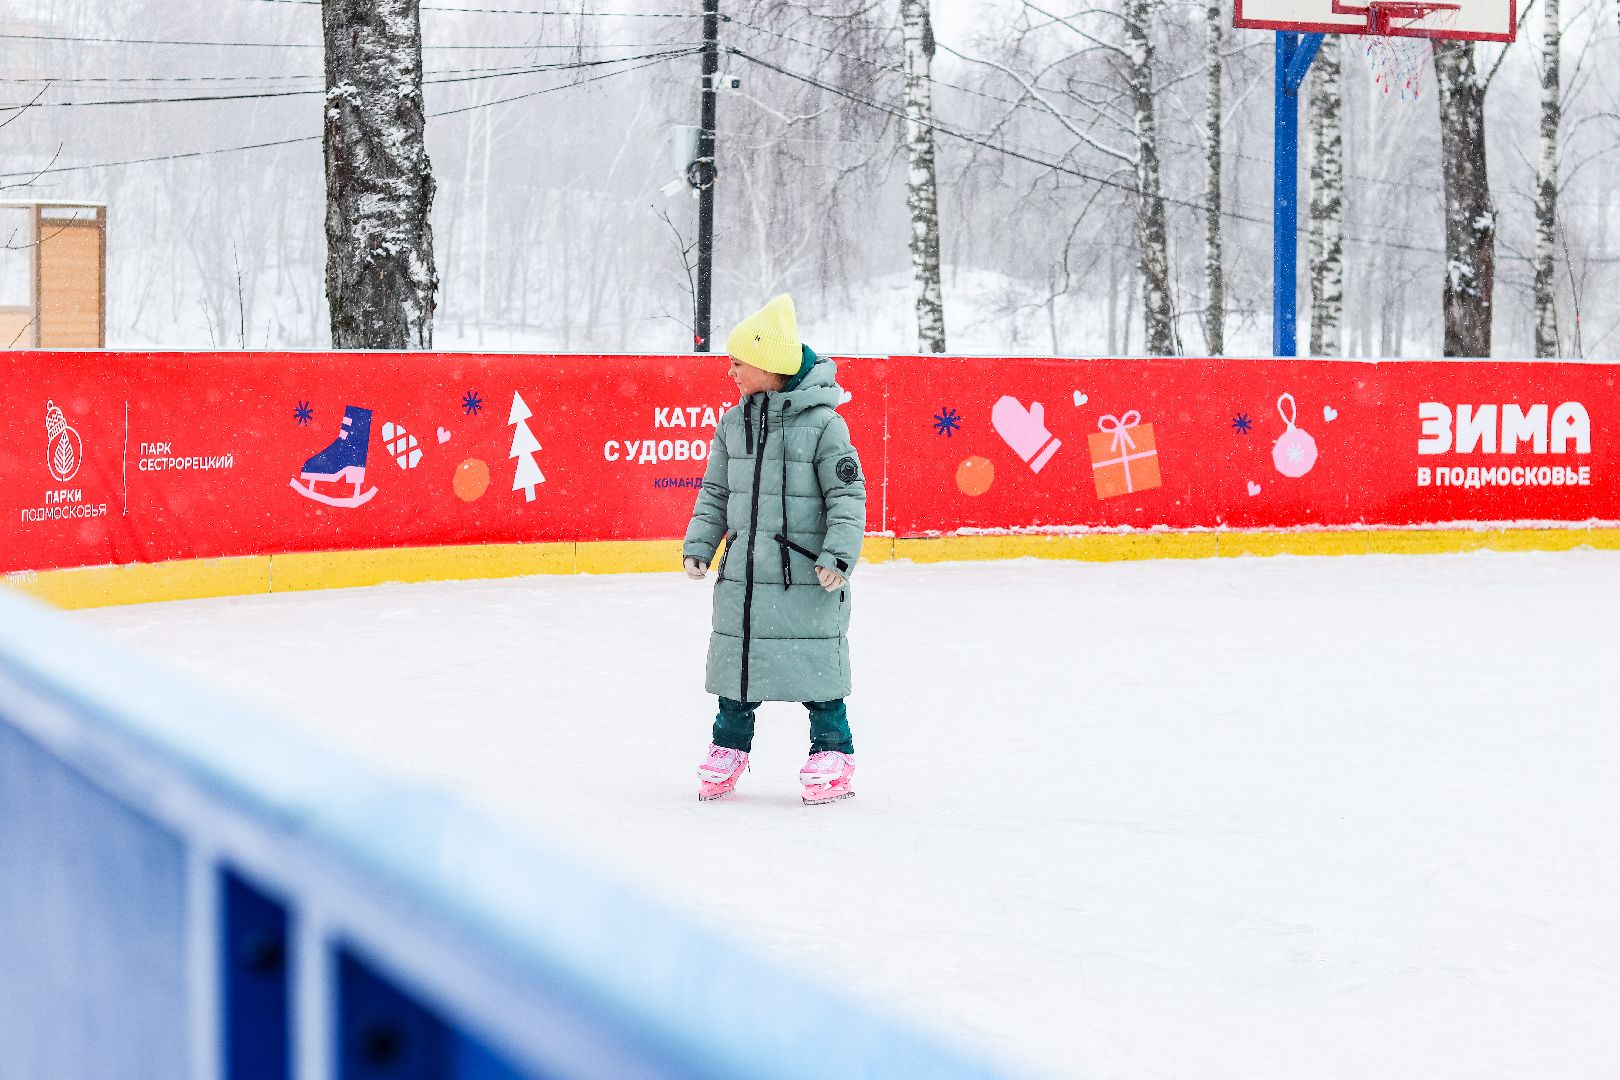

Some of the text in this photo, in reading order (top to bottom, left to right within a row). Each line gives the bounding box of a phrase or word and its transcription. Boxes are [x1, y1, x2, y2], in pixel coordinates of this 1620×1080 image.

[1417, 401, 1591, 454] ЗИМА
[140, 442, 172, 455] ПАРК
[604, 440, 620, 461] С
[138, 453, 233, 471] СЕСТРОРЕЦКИЙ
[1417, 466, 1591, 488] В ПОДМОСКОВЬЕ
[46, 489, 82, 504] ПАРКИ
[21, 504, 107, 522] ПОДМОСКОВЬЯ
